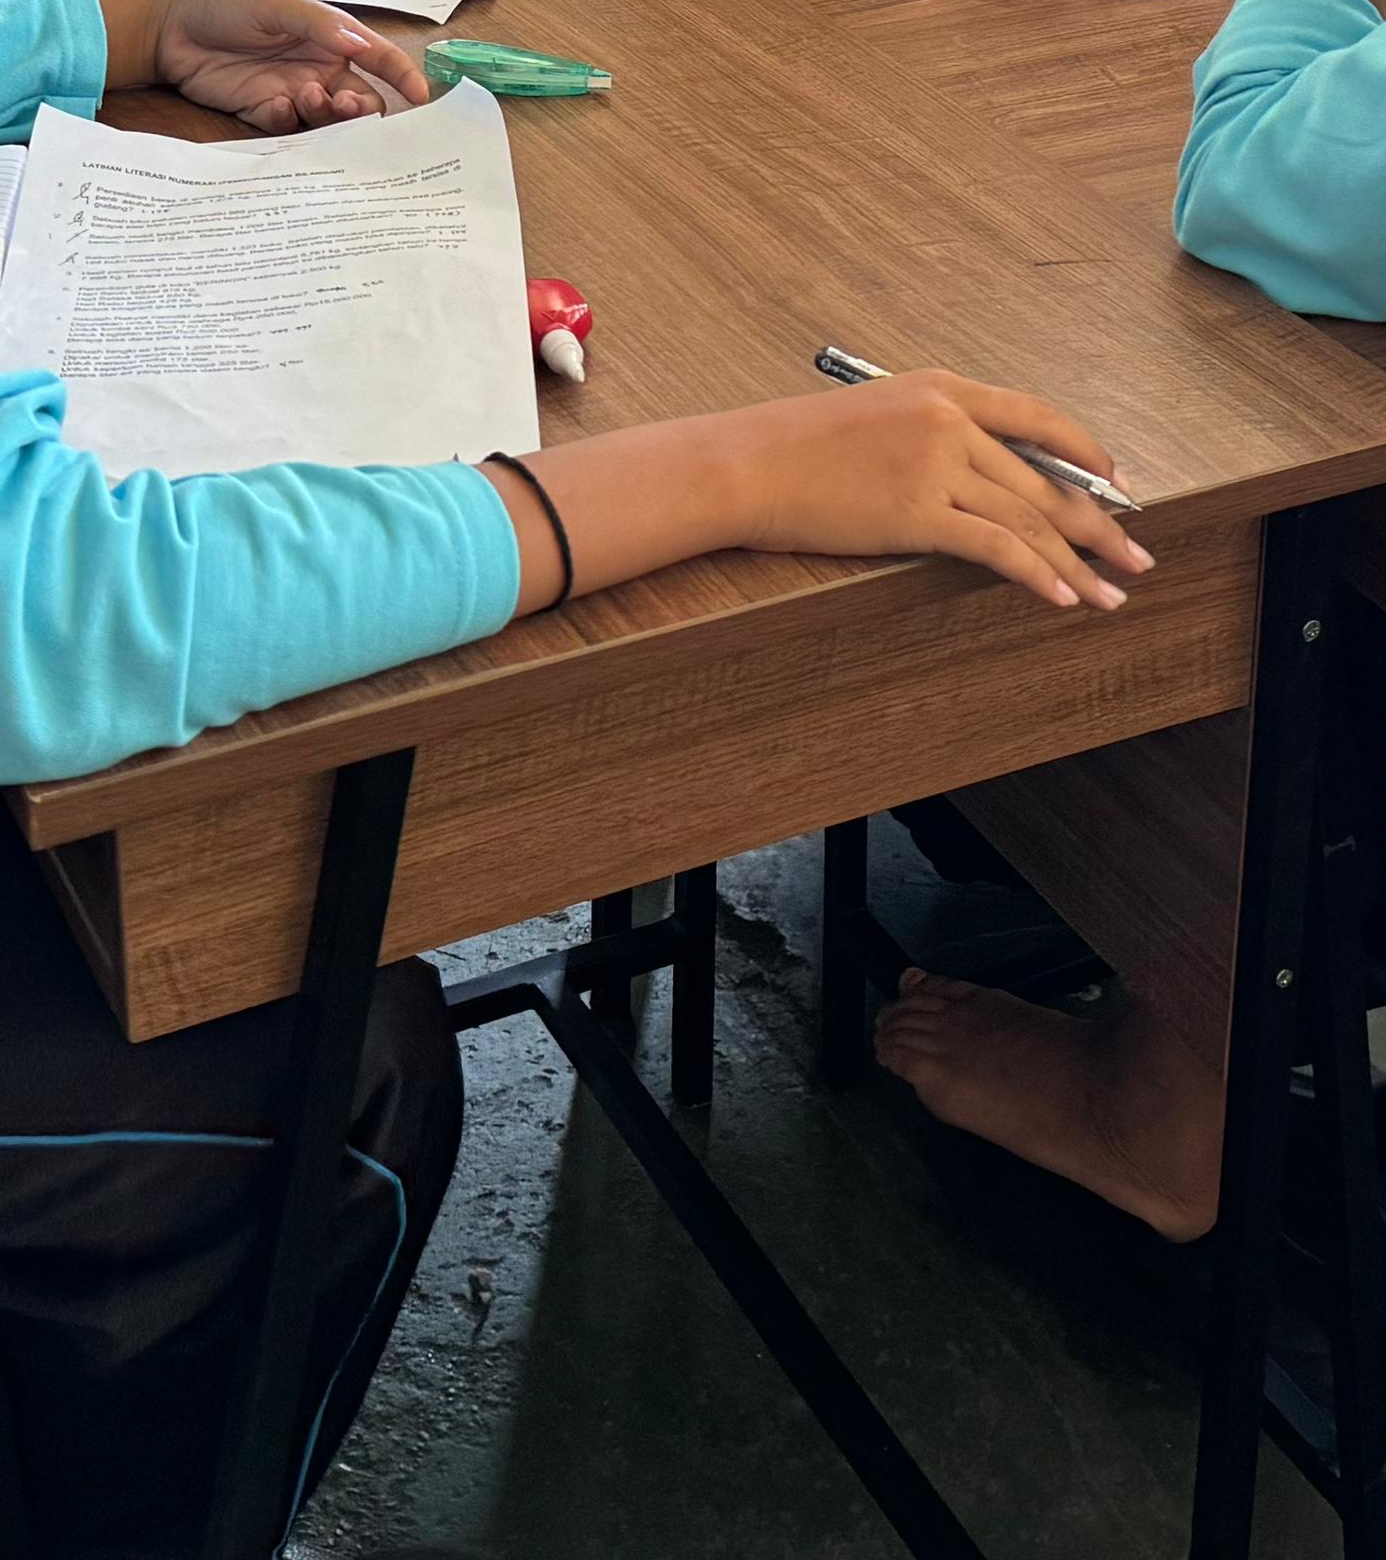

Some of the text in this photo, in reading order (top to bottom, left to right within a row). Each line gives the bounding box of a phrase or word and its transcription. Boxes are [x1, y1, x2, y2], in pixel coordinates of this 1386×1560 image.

[82, 161, 122, 172] LATIHAN
[124, 168, 167, 180] LITERASI
[168, 175, 217, 186] NUMERASI
